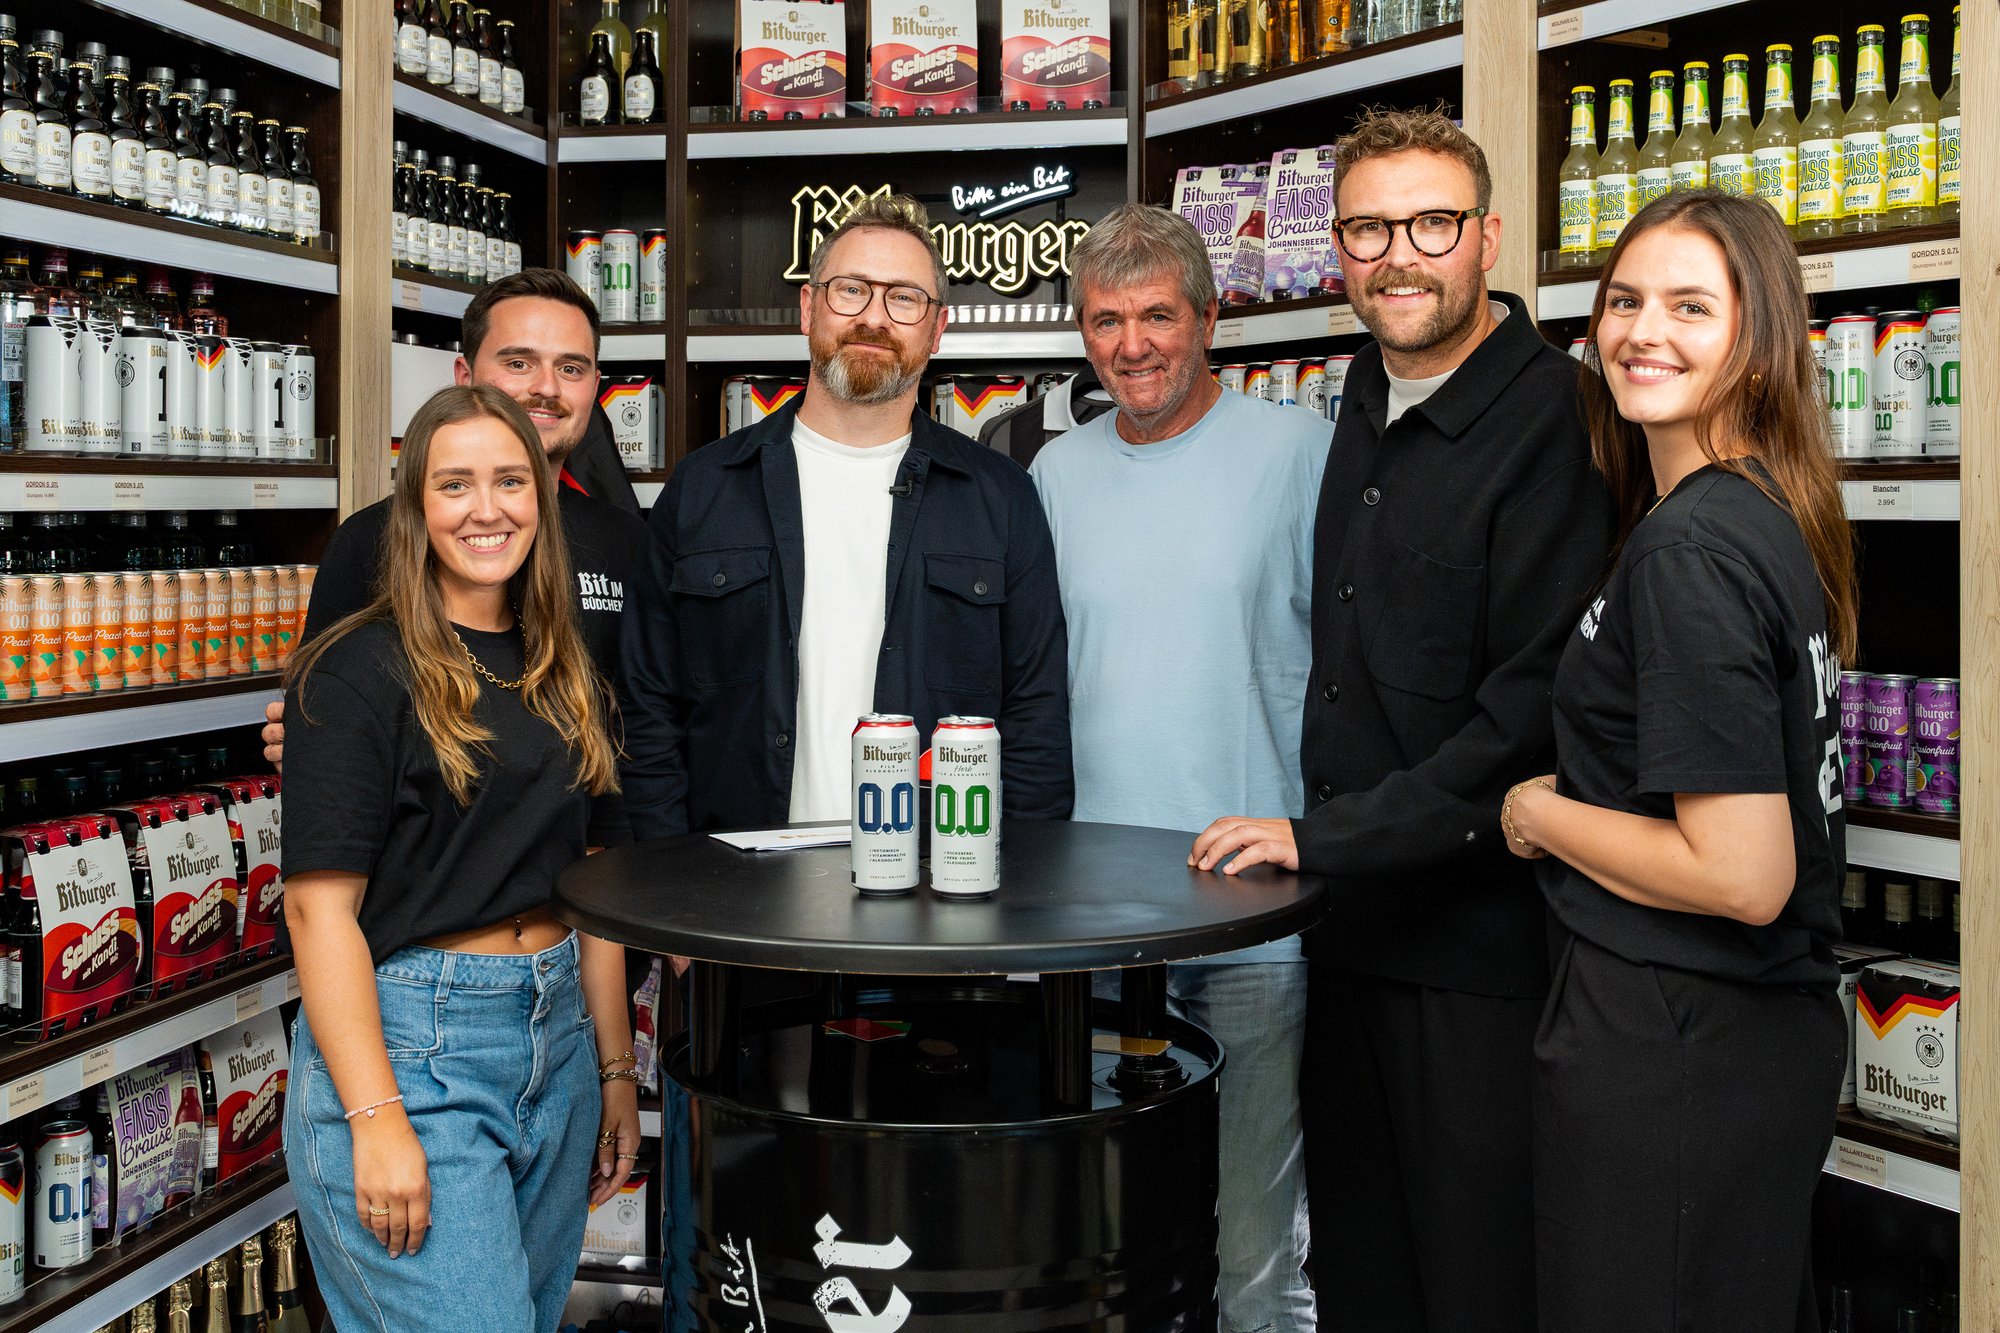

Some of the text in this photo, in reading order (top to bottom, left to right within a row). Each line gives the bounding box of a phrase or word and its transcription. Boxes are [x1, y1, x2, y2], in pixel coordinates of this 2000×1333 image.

[761, 21, 828, 45] Bitburger
[892, 16, 958, 40] Bitburger
[1023, 9, 1090, 31] Bitburger
[891, 45, 958, 82] Schuss
[1022, 36, 1090, 75] Schuss
[1056, 55, 1086, 76] Kandi
[760, 52, 827, 86] Schuss
[793, 68, 823, 88] Kandi
[924, 63, 954, 83] Kandi
[951, 165, 1070, 210] Bitte ein Bit
[1276, 169, 1333, 188] Bitburger
[1181, 186, 1236, 204] Bitburger
[1274, 185, 1330, 222] FASS
[1267, 215, 1331, 240] Brause
[1201, 234, 1234, 248] ause
[1267, 237, 1331, 249] JOHANNISBEERE
[1911, 246, 1960, 259] GORDON S 0.7L
[1816, 261, 1822, 269] S
[1874, 413, 1893, 431] 0.0
[1872, 484, 1901, 493] Blanchet
[1877, 498, 1896, 507] 2.99€
[577, 571, 624, 598] Bit IM
[581, 595, 624, 613] BÜDCHEN
[1869, 715, 1890, 732] 0.0
[1919, 720, 1942, 737] 0.0
[862, 745, 912, 764] Bitburger
[938, 746, 989, 766] Bitburger
[954, 765, 973, 773] Herb
[858, 782, 917, 836] 0.0
[935, 783, 992, 837] 0.0
[166, 852, 221, 883] Bitburger
[55, 879, 117, 913] Bitburger
[169, 880, 223, 946] Schuss
[197, 904, 221, 938] Kandi
[61, 909, 120, 981] Schuss
[91, 936, 118, 974] Kandi
[227, 1048, 275, 1084] Bitburger
[114, 1069, 165, 1103] Bitburger
[1863, 1062, 1948, 1113] Bitburger
[118, 1086, 171, 1143] FASS
[232, 1073, 278, 1143] Schuss
[255, 1097, 277, 1133] Kandi
[119, 1126, 173, 1169] Brause
[1838, 1144, 1876, 1161] BALLANTINES
[120, 1147, 174, 1181] JOHANNISBEERE
[48, 1175, 93, 1225] 0.0
